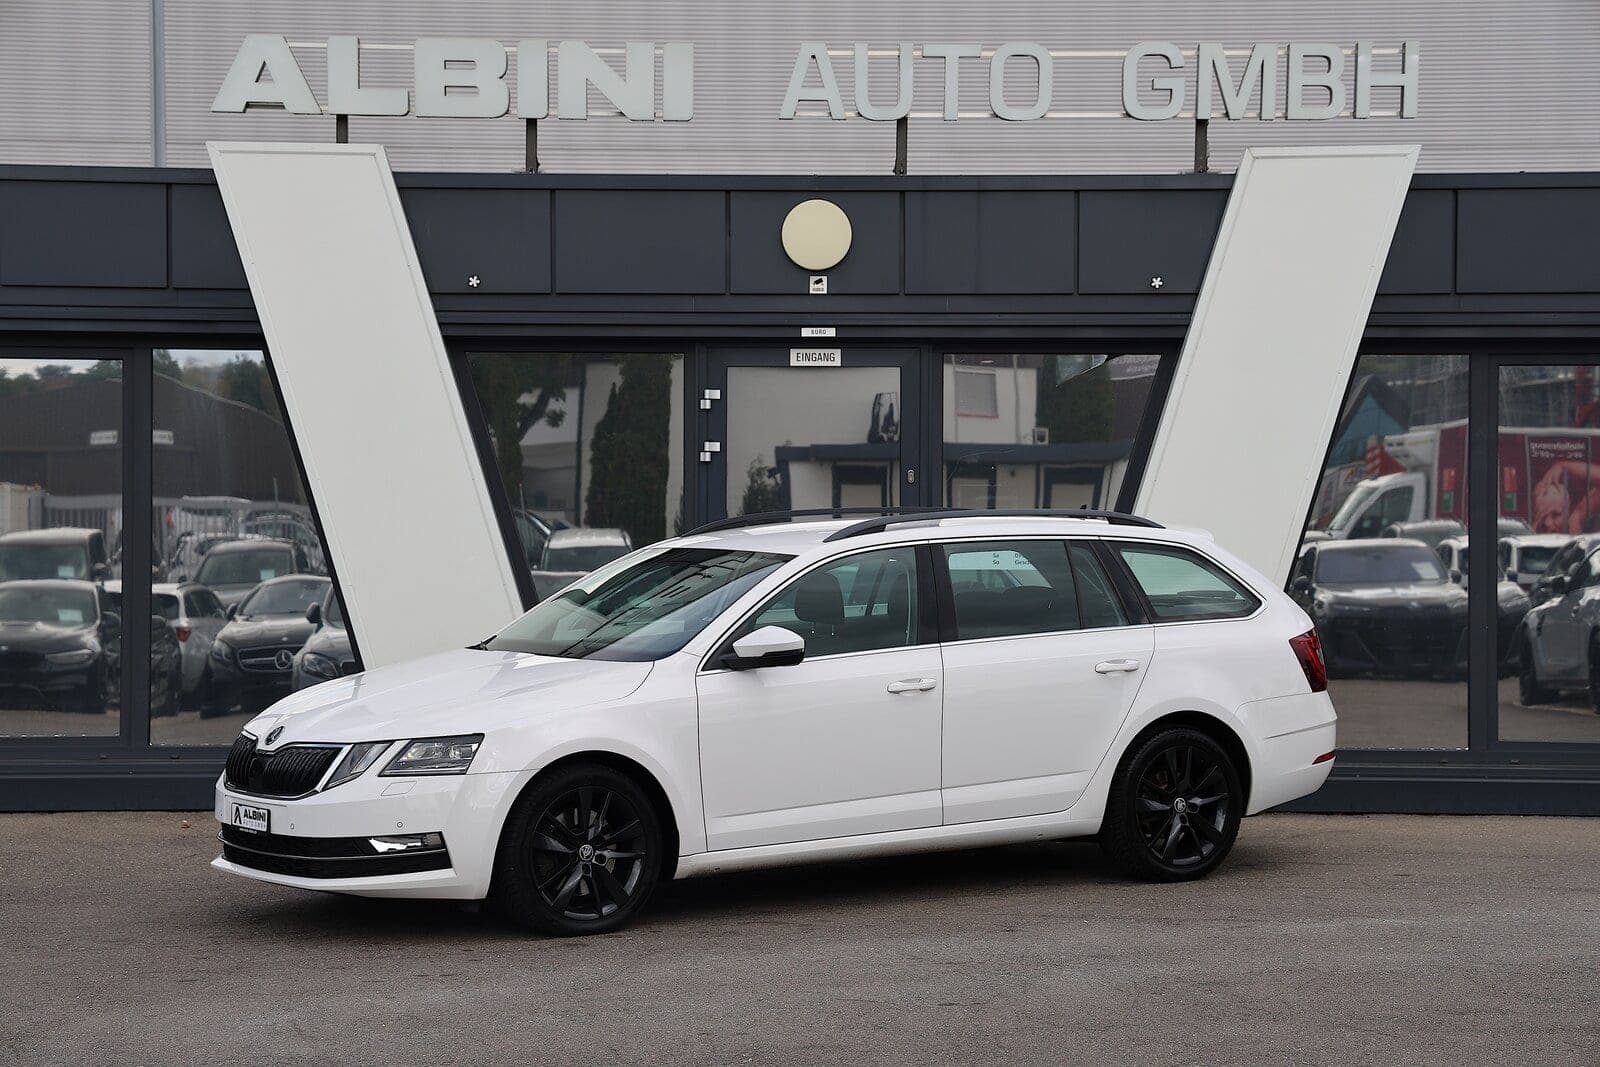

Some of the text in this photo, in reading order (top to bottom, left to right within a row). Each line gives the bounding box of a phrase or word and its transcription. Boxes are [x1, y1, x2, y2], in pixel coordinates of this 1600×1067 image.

[211, 35, 1420, 121] ALBINI AUTO GMBH
[796, 352, 836, 362] EINGANG
[243, 808, 266, 823] ALBINI
